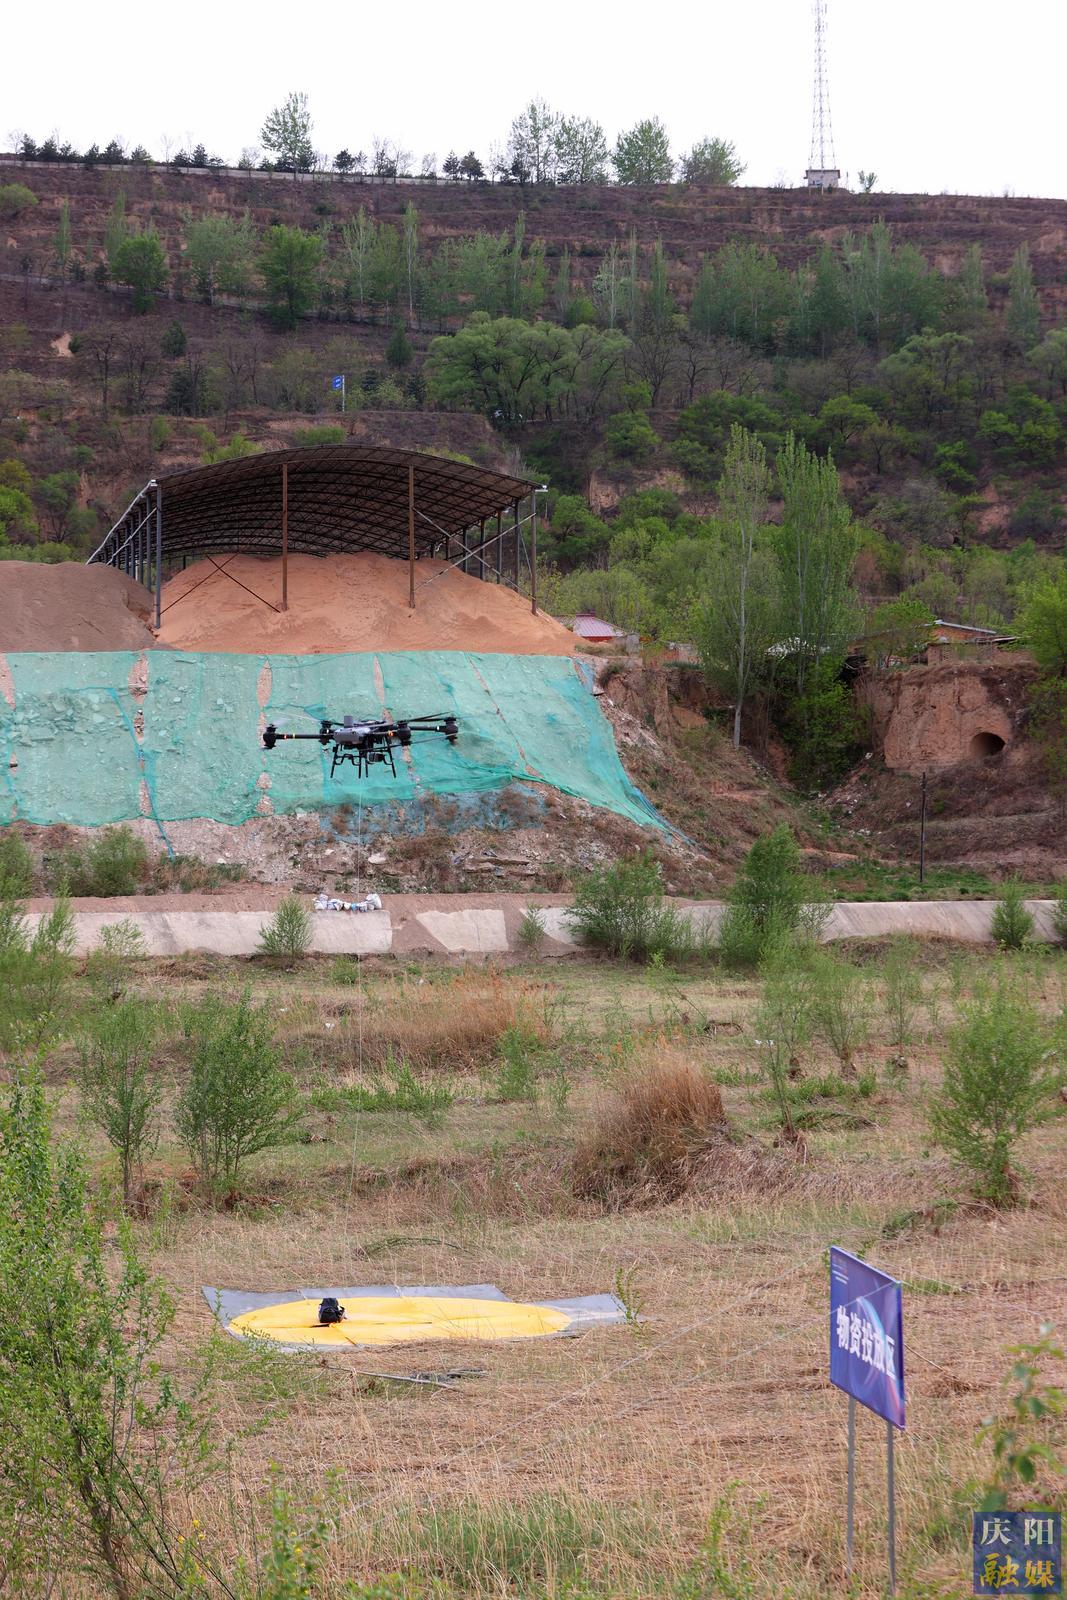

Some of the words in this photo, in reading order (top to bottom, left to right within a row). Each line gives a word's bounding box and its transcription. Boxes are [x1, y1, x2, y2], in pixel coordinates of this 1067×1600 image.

[837, 1305, 896, 1380] 物资投放区
